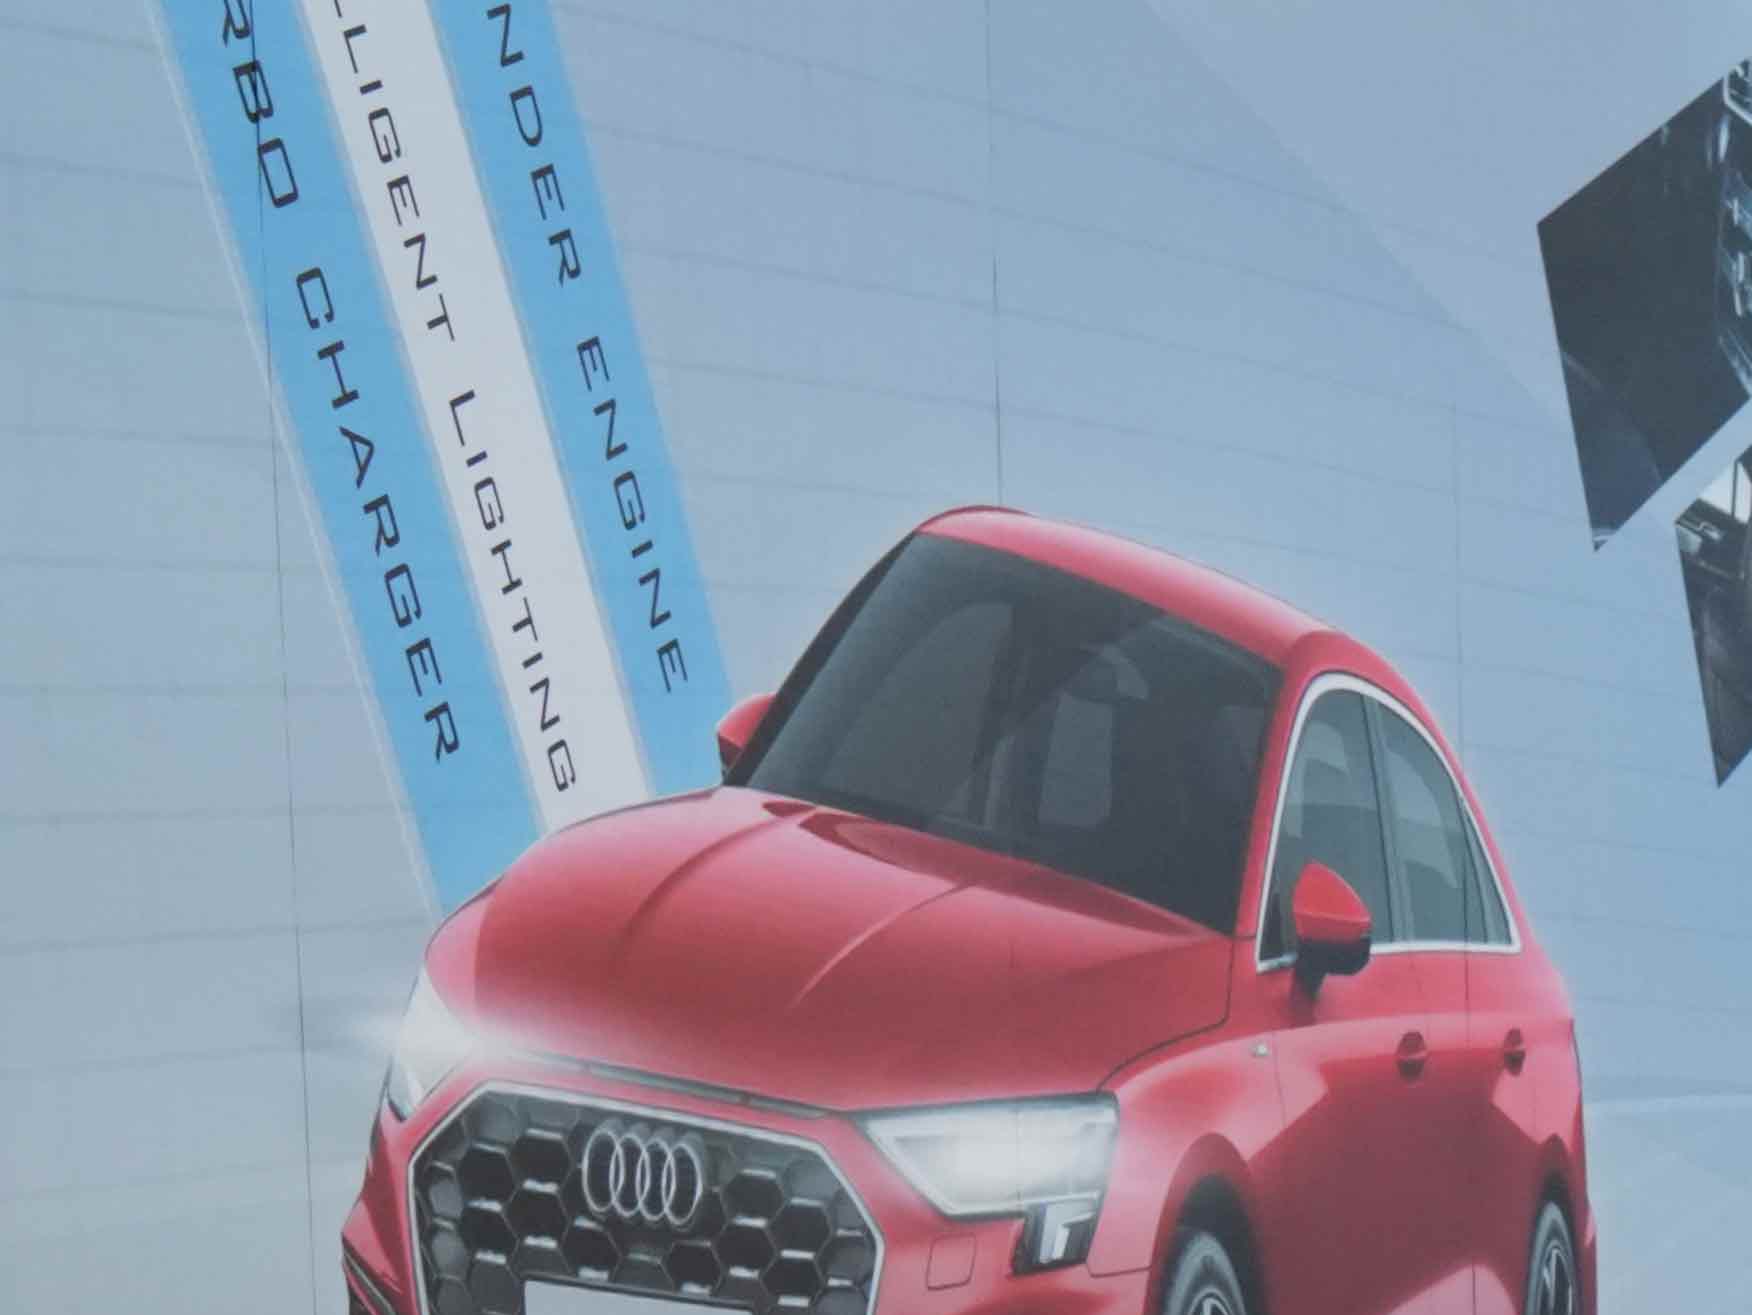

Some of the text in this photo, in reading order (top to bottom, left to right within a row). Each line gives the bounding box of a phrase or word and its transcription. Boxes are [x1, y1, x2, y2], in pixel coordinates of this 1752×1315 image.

[295, 267, 461, 761] CHARGER
[334, 0, 577, 791] LIGENT LIGHTING
[577, 336, 688, 693] ENGINE
